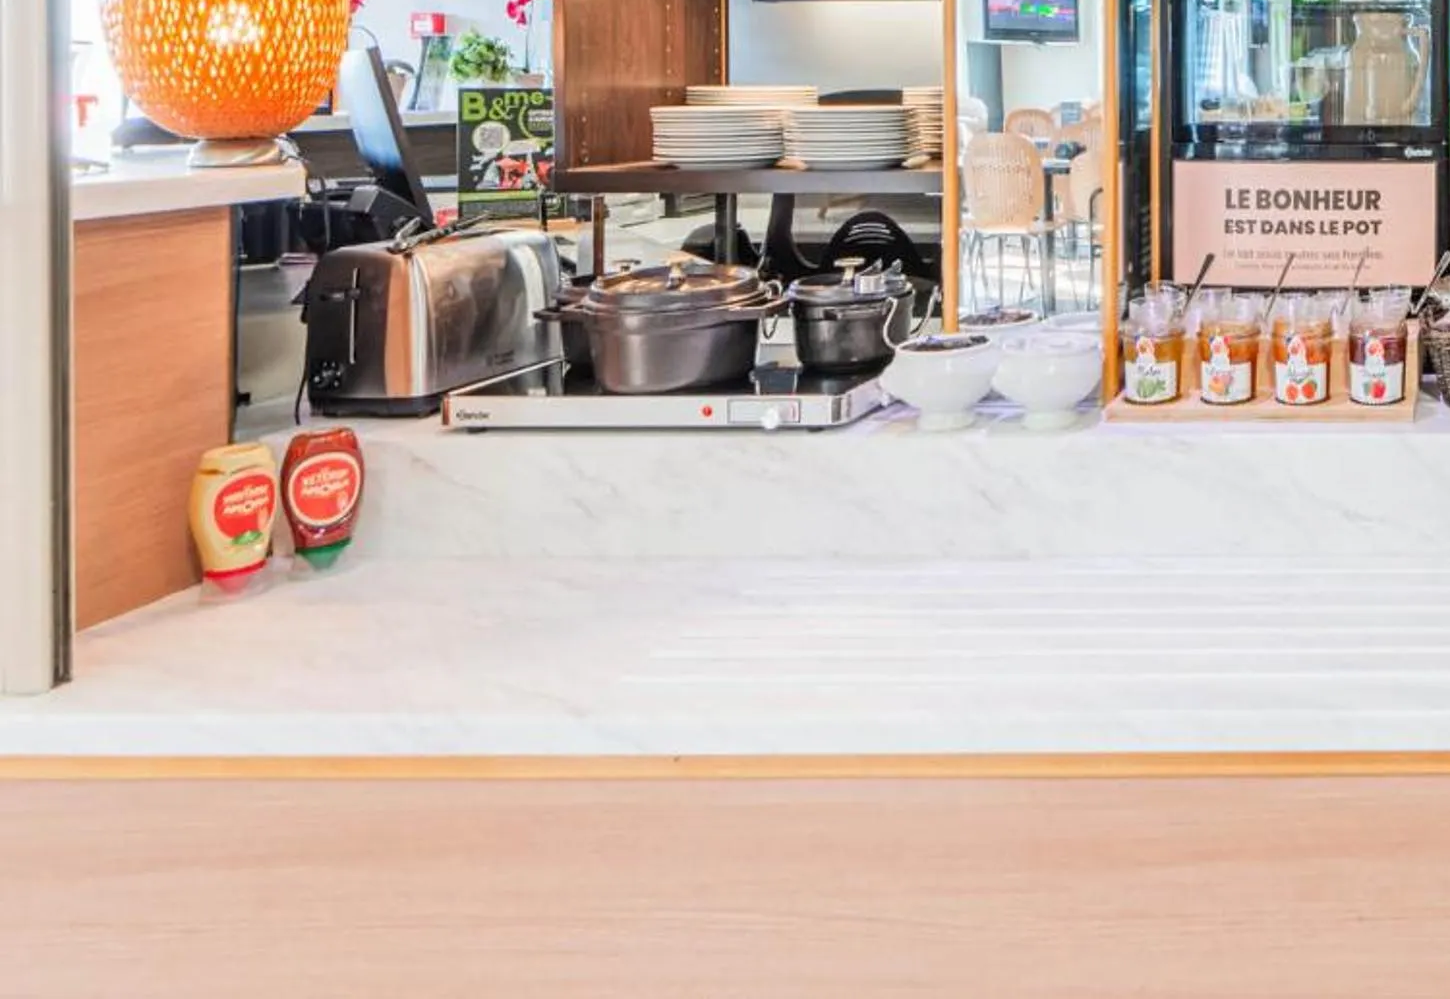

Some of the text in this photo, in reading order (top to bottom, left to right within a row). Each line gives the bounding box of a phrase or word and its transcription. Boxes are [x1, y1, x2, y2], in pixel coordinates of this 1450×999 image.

[1225, 188, 1382, 211] LE BONHEUR
[1223, 219, 1383, 236] EST DANS LE POT
